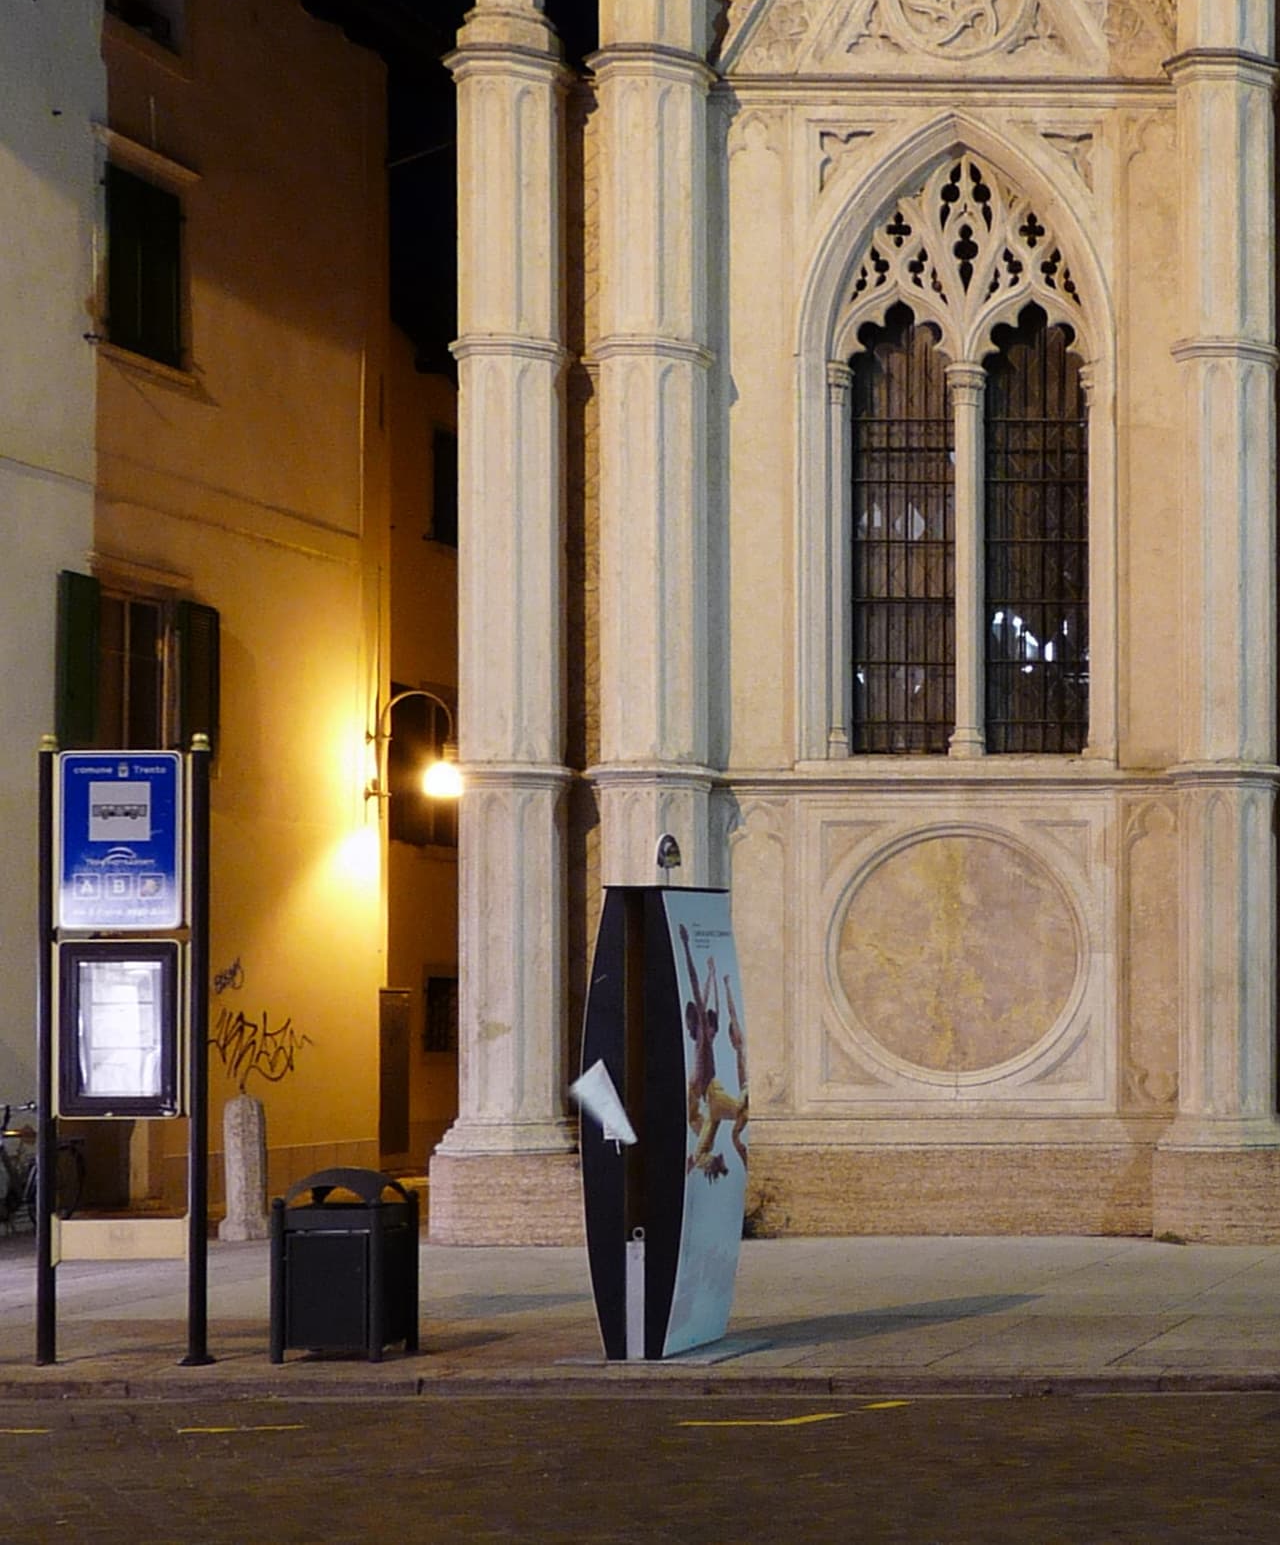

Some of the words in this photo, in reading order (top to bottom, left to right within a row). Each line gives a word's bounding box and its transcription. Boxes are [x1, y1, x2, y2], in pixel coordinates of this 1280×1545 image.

[132, 764, 167, 775] Trento
[80, 879, 94, 894] A
[112, 879, 125, 894] B
